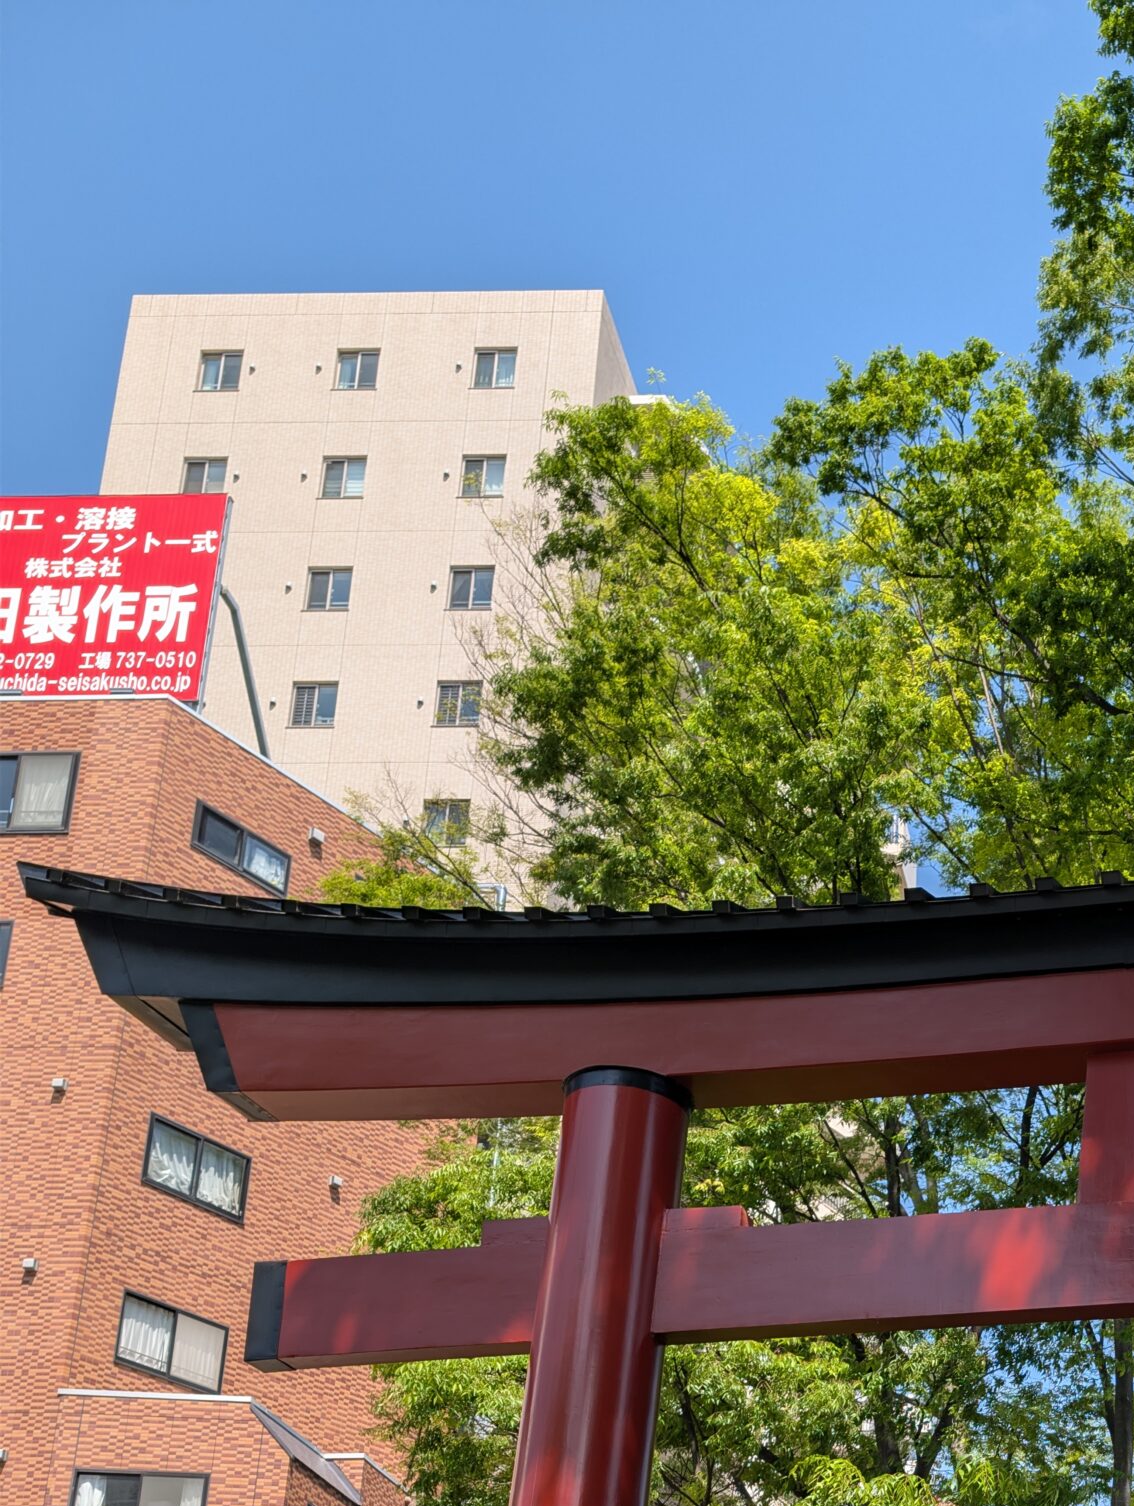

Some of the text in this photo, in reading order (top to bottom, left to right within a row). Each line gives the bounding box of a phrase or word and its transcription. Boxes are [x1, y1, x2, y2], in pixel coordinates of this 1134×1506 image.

[62, 531, 218, 554] プラント一式
[24, 556, 122, 578] 株式会社
[78, 651, 112, 669] 工場
[116, 651, 197, 669] 737-0510
